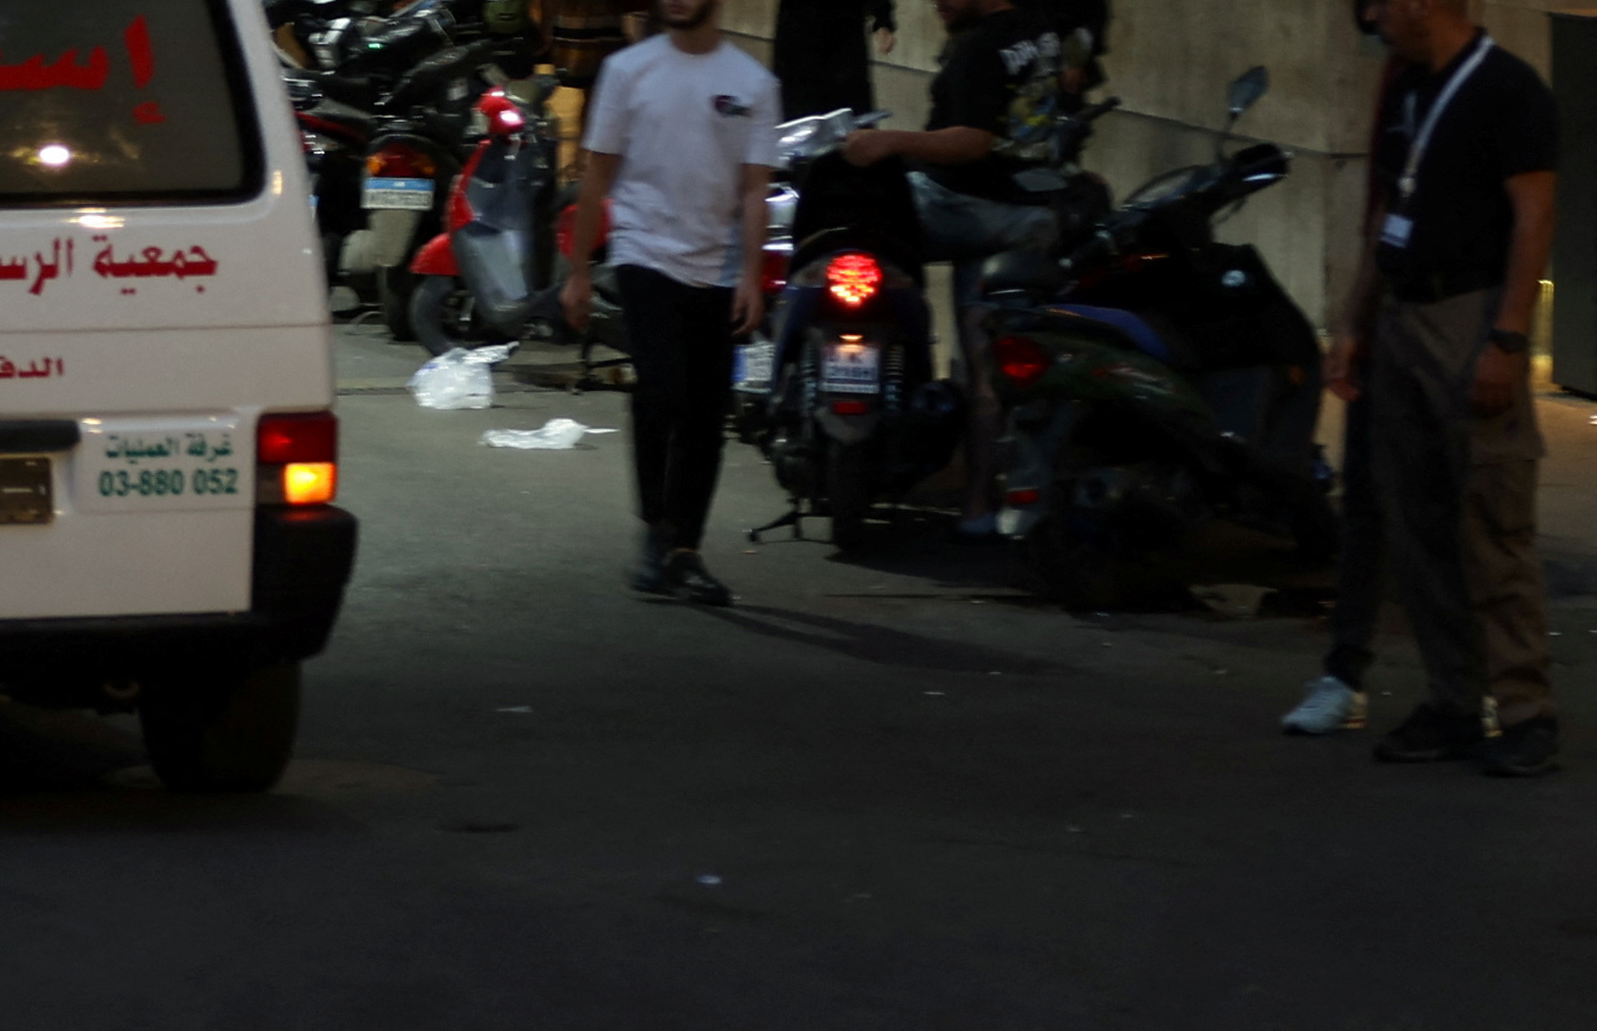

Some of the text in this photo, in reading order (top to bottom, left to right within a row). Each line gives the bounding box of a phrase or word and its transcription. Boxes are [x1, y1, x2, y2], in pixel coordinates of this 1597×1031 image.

[92, 234, 219, 295] جمعية
[106, 432, 233, 465] غرفة العمليات
[99, 467, 240, 497] 03-880 052
